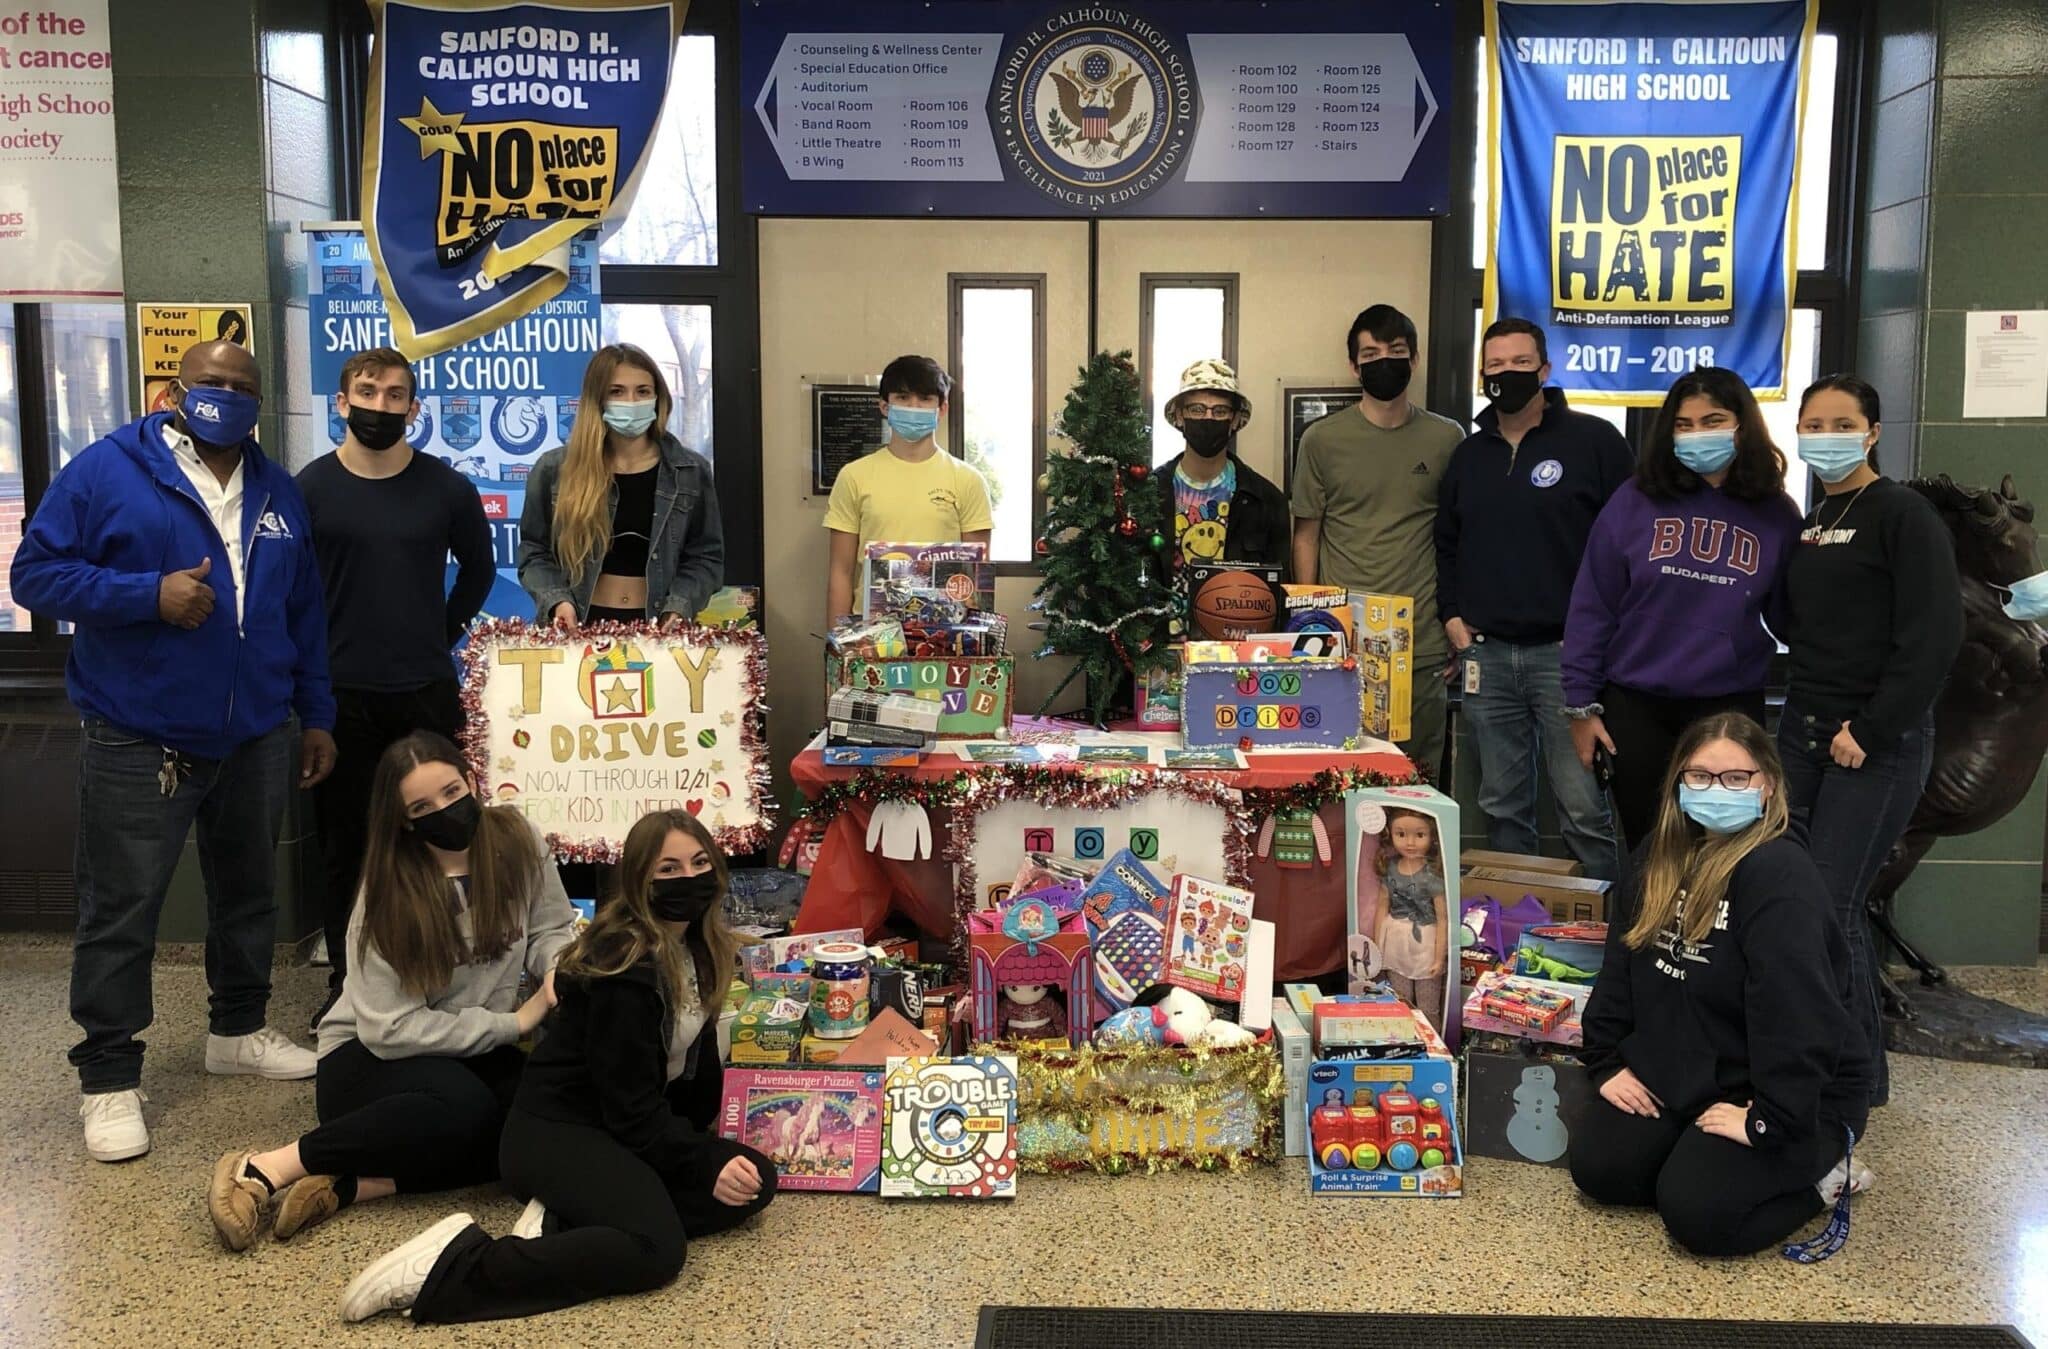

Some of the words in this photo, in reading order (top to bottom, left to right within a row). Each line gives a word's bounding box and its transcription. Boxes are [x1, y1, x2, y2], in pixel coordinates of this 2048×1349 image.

[1, 12, 30, 36] of
[36, 11, 86, 36] the
[440, 25, 580, 54] SANFORD
[589, 32, 619, 55] H.
[800, 44, 870, 59] Counseling
[871, 45, 880, 55] &
[883, 44, 940, 55] Wellness
[941, 44, 983, 56] Center
[1517, 37, 1626, 65] SANFORD
[1637, 38, 1661, 65] H.
[1672, 37, 1786, 64] CALHOUN
[418, 54, 559, 81] CALHOUN
[567, 57, 641, 82] HIGH
[800, 63, 845, 77] Special
[848, 63, 910, 74] Education
[912, 63, 948, 74] Office
[1000, 46, 1029, 124] SANFORD
[1028, 31, 1046, 48] H.
[1046, 8, 1131, 33] CALHOUN
[1131, 18, 1172, 54] HIGH
[1166, 53, 1191, 124] SCHOOL
[1238, 65, 1274, 76] Room
[1276, 65, 1297, 76] 102
[1323, 65, 1359, 76] Room
[1361, 65, 1381, 76] 126
[800, 82, 868, 93] Auditorium
[1238, 84, 1274, 95] Room
[1276, 84, 1298, 95] 100
[1323, 84, 1359, 95] Room
[1361, 84, 1381, 95] 125
[1567, 75, 1626, 101] HIGH
[1636, 74, 1731, 101] SCHOOL
[470, 81, 589, 110] SCHOOL
[0, 93, 33, 122] igh
[37, 92, 113, 115] Schoo
[801, 101, 835, 112] Vocal
[838, 101, 873, 112] Room
[910, 101, 945, 112] Room
[947, 101, 969, 112] 106
[1238, 103, 1273, 114] Room
[1276, 103, 1296, 114] 129
[1322, 103, 1358, 114] Room
[1361, 103, 1380, 114] 124
[418, 124, 453, 137] GOLD
[801, 119, 835, 130] Band
[838, 119, 871, 130] Room
[910, 120, 945, 130] Room
[947, 120, 969, 130] 109
[1238, 121, 1273, 133] Room
[1276, 121, 1296, 133] 128
[1322, 121, 1358, 133] Room
[1361, 121, 1379, 133] 123
[0, 127, 64, 156] ociety
[801, 138, 830, 149] Little
[832, 138, 882, 149] Theatre
[910, 138, 945, 149] Room
[947, 138, 961, 149] 111
[1238, 140, 1273, 151] Room
[1276, 140, 1293, 151] 127
[1321, 140, 1358, 151] Stairs
[539, 134, 607, 171] place
[451, 127, 535, 200] NO
[802, 157, 811, 168] B
[813, 156, 844, 170] Wing
[910, 157, 945, 168] Room
[947, 157, 965, 168] 113
[1656, 144, 1728, 191] place
[1006, 139, 1085, 206] EXCELLENCE
[1089, 194, 1105, 206] IN
[1110, 140, 1182, 204] EDUCATION
[1081, 171, 1106, 182] 2021
[544, 173, 608, 201] for
[1560, 144, 1651, 225] NO
[1661, 188, 1729, 225] for
[0, 212, 24, 226] DES
[328, 245, 341, 256] 20
[447, 246, 464, 260] An
[1558, 229, 1726, 302] HATE
[152, 309, 189, 320] Your
[545, 299, 589, 315] DISTRICT
[1555, 311, 1670, 326] Anti-Defamation
[1673, 312, 1730, 328] League
[144, 326, 198, 337] Future
[479, 318, 598, 353] CALHOUN
[164, 344, 179, 354] Is
[1566, 344, 1622, 373] 2017
[1650, 345, 1715, 373] 2018
[412, 358, 436, 390] GH
[445, 357, 545, 391] SCHOOL
[1648, 516, 1761, 576] BUD
[916, 550, 956, 561] Giant
[1661, 565, 1737, 585] BUDAPEST
[1215, 596, 1271, 613] SPALDING
[891, 665, 968, 686] TOY
[1220, 709, 1316, 725] Drive
[550, 721, 689, 763] DRIVE
[524, 770, 572, 793] NOW
[579, 768, 668, 792] THROUGH
[675, 768, 710, 790] 12/21
[525, 798, 563, 825] FOR
[567, 798, 604, 824] KIDS
[610, 798, 630, 823] IN
[1031, 833, 1151, 857] Toy
[1114, 865, 1155, 903] CONNECT
[901, 971, 922, 1018] NERF
[1329, 1048, 1371, 1062] CHALK
[754, 1073, 820, 1089] Ravensburger
[823, 1075, 855, 1087] Puzzle
[865, 1075, 878, 1085] 6+
[888, 1077, 1012, 1111] TROUBLE
[980, 1100, 1005, 1110] GAME
[725, 1104, 740, 1127] 100
[967, 1120, 982, 1129] TRY
[1320, 1173, 1339, 1182] Roll
[1341, 1173, 1348, 1182] &
[1350, 1173, 1389, 1183] Surprise
[1320, 1182, 1353, 1191] Animal
[1356, 1182, 1379, 1191] Train
